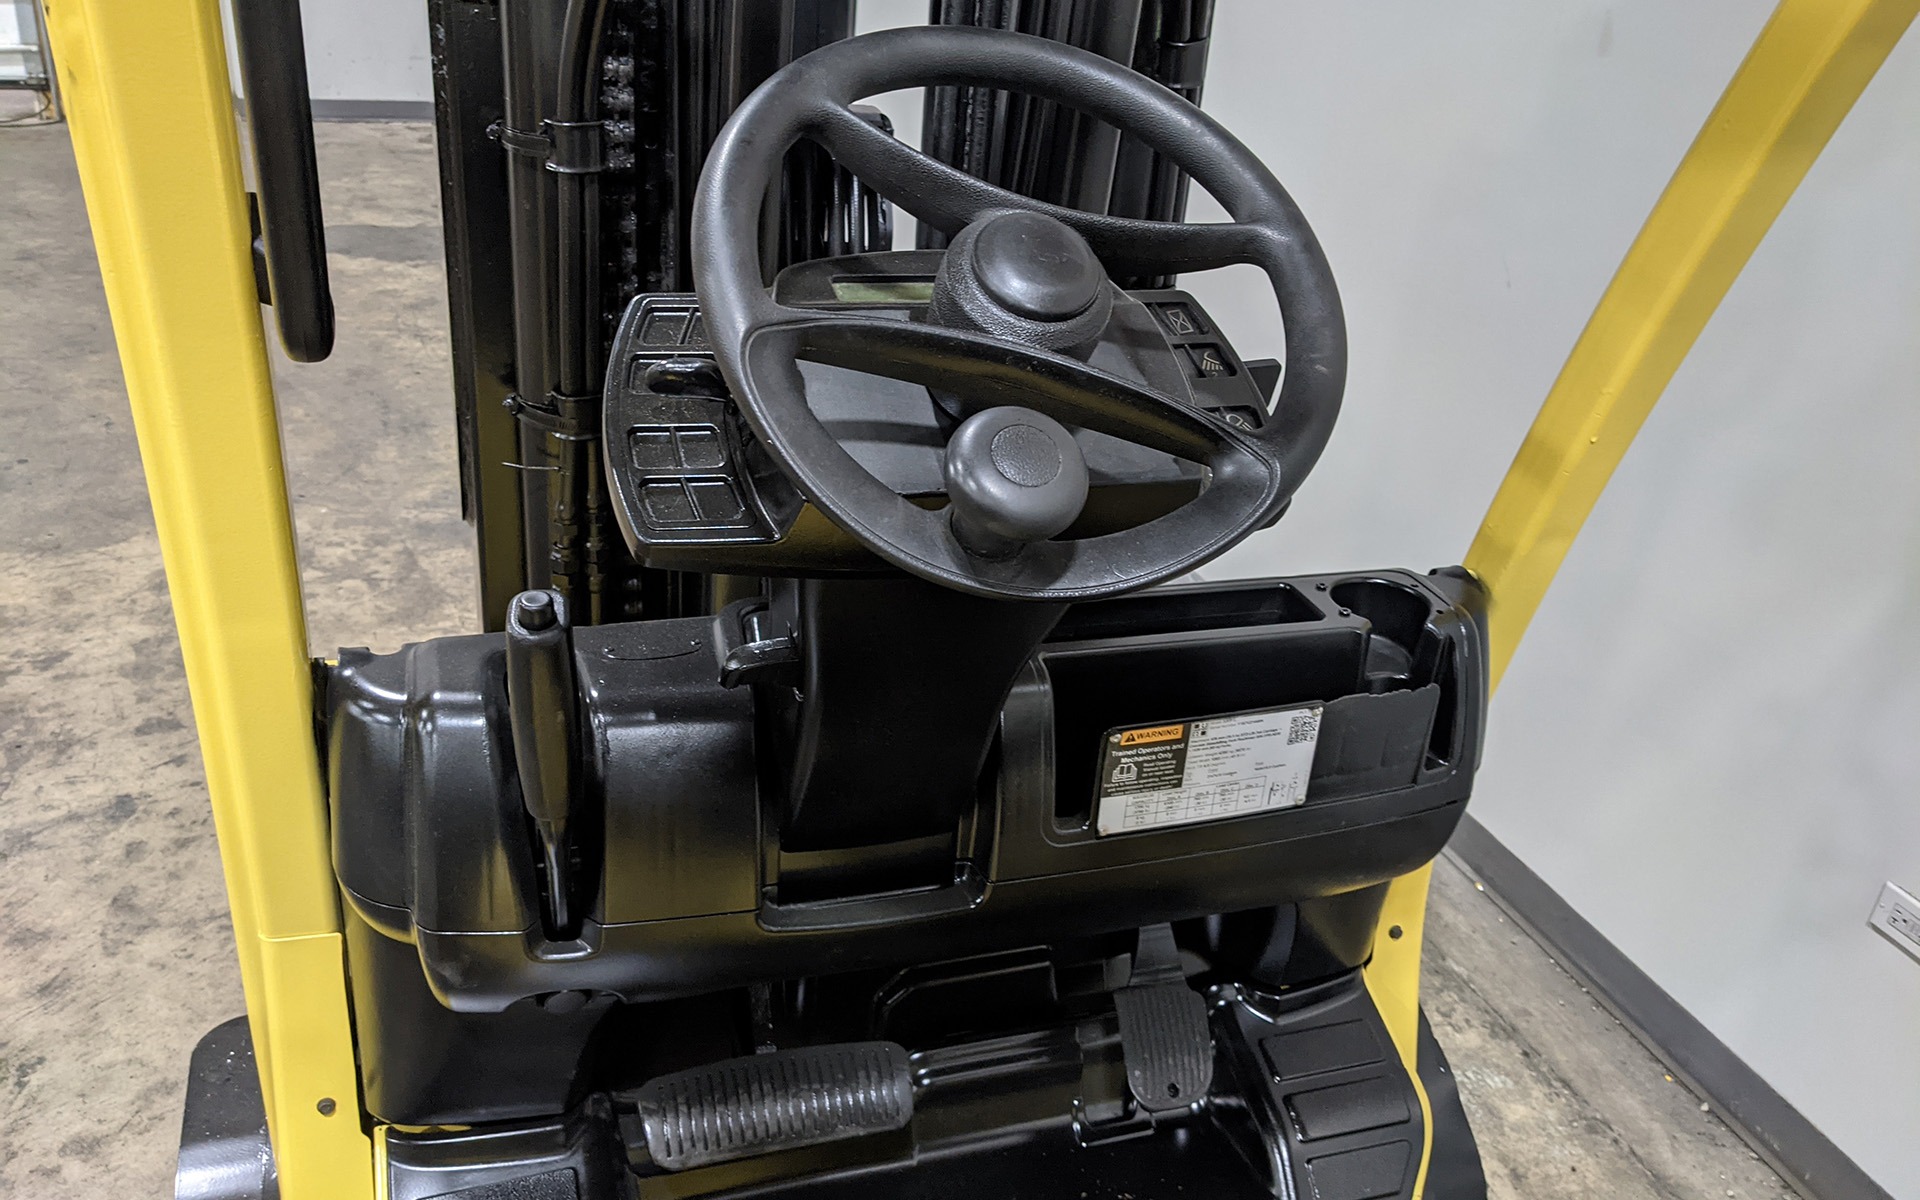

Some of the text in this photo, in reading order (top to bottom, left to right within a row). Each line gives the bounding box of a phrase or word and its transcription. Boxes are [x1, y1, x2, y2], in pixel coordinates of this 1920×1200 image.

[1136, 728, 1179, 739] WARNING
[1111, 749, 1137, 757] Trained
[1137, 745, 1170, 754] Operators
[1120, 752, 1174, 763] Mechanics Only
